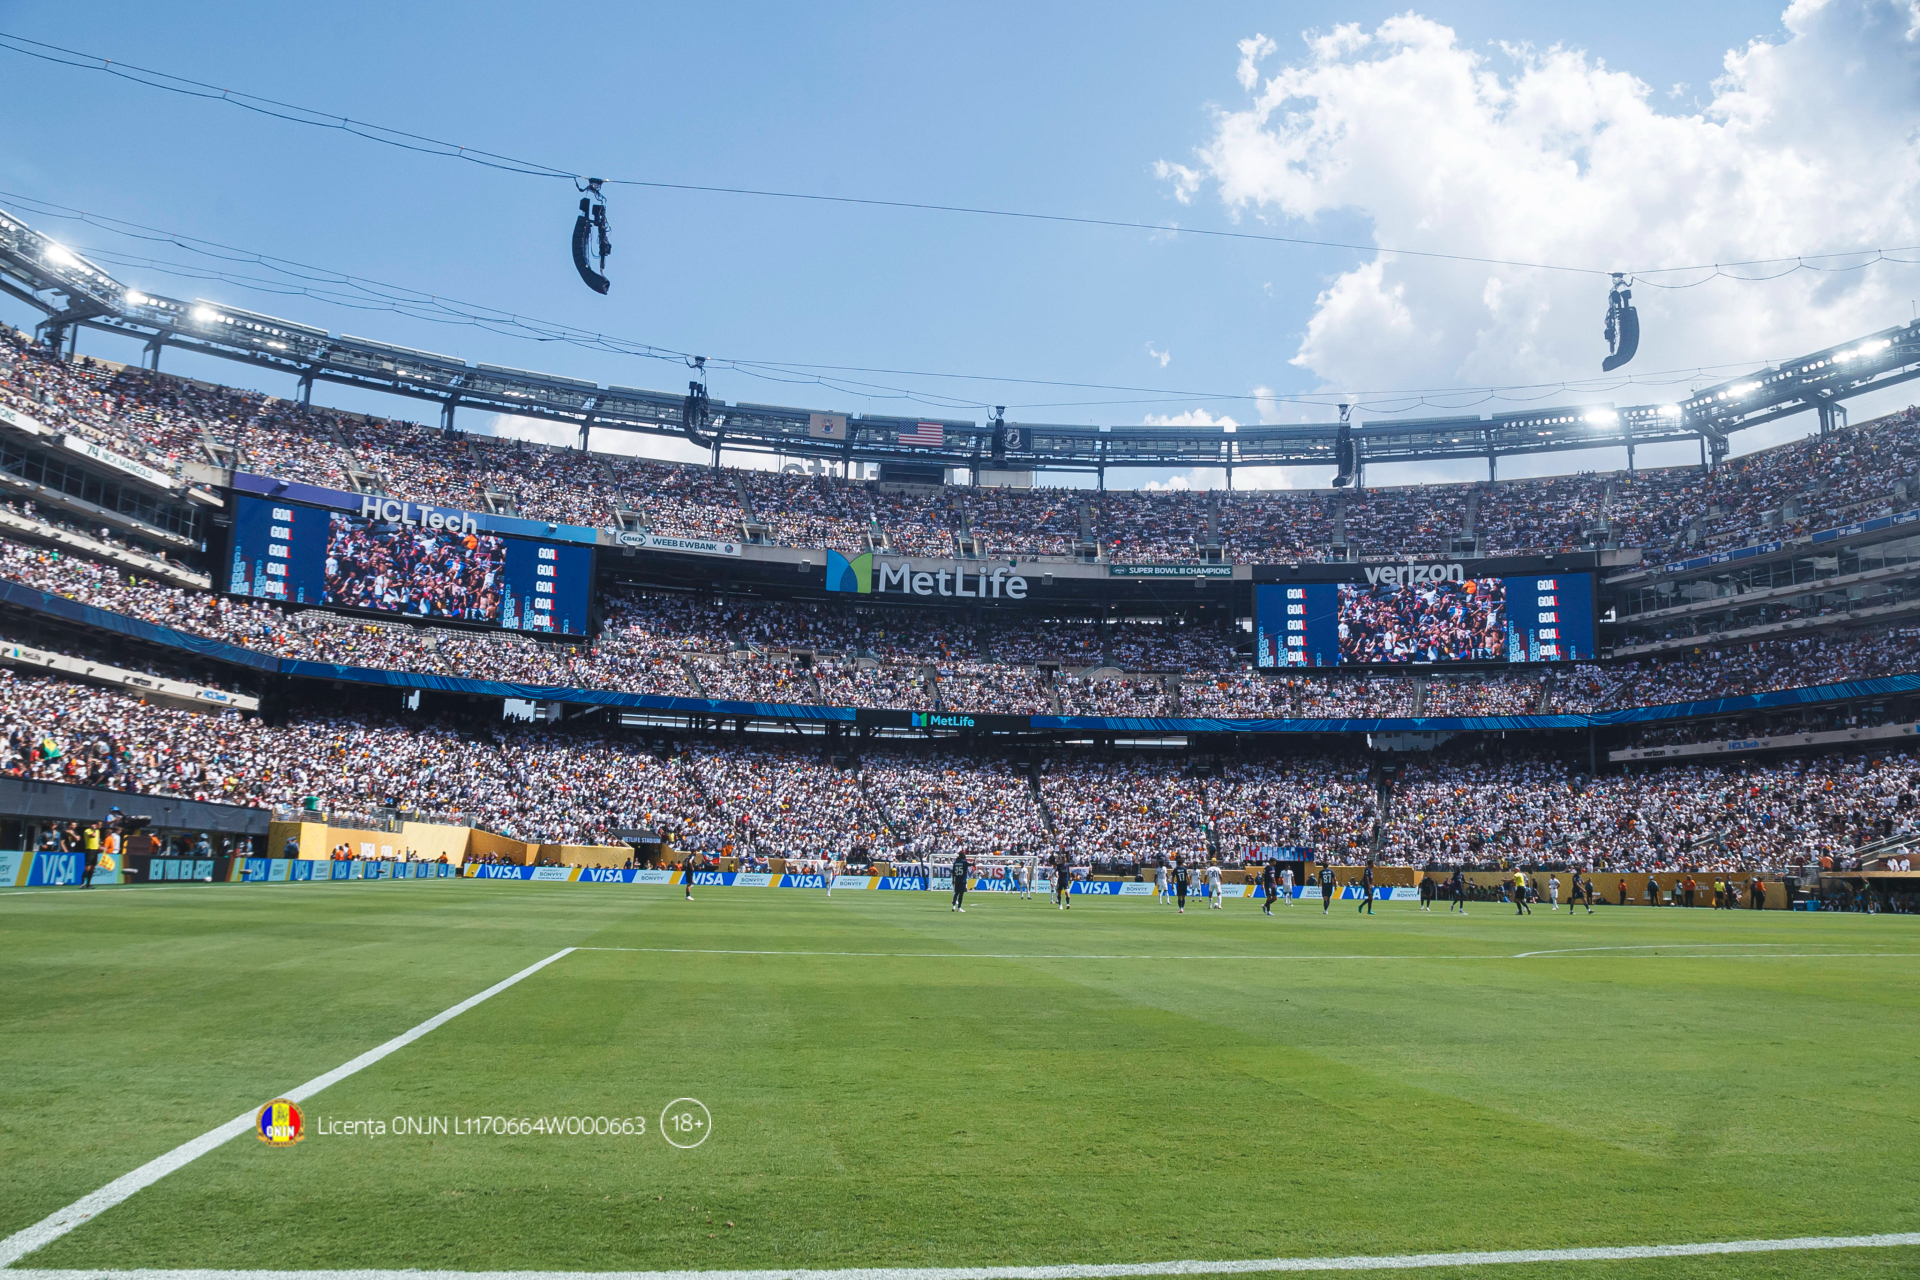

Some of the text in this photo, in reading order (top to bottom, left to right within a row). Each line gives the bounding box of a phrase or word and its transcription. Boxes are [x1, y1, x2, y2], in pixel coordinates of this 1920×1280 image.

[86, 443, 98, 457] 74
[117, 458, 153, 479] MANGOLD
[272, 508, 295, 522] GOAL
[361, 496, 477, 535] HCLTech
[270, 526, 293, 540] GOAL
[622, 534, 717, 551] COACH WEEB EWBANK
[268, 544, 291, 558] GOAL
[538, 547, 559, 560] GOAL
[267, 562, 290, 577] GOAL
[537, 564, 557, 577] GOAL
[1185, 567, 1231, 575] CHAMPIONS
[1364, 560, 1464, 584] verizon
[878, 561, 1028, 599] MetLife
[1537, 579, 1559, 591] GOAL
[265, 580, 288, 594] GOAL
[536, 581, 556, 594] GOAL
[1287, 588, 1307, 599] GOAL
[534, 598, 555, 611] GOAL
[1538, 595, 1559, 607] GOAL
[1287, 604, 1307, 615] GOAL
[533, 615, 554, 627] GOAL
[1538, 612, 1560, 623] GOAL
[1287, 620, 1307, 630] GOAL
[1539, 628, 1561, 639] GOAL
[1287, 635, 1308, 646] GOAL
[1288, 651, 1307, 662] GOAL
[1540, 644, 1560, 656] GOAL
[930, 715, 975, 727] MetLife
[1728, 740, 1759, 750] HCLTech
[40, 854, 76, 884] VISA
[487, 865, 522, 879] VISA
[590, 869, 623, 882] VISA
[790, 875, 823, 888] VISA
[1177, 872, 1185, 881] 17
[1322, 874, 1332, 884] 87
[887, 877, 920, 890] VISA
[1078, 881, 1116, 894] VISA
[1350, 887, 1381, 899] VIA
